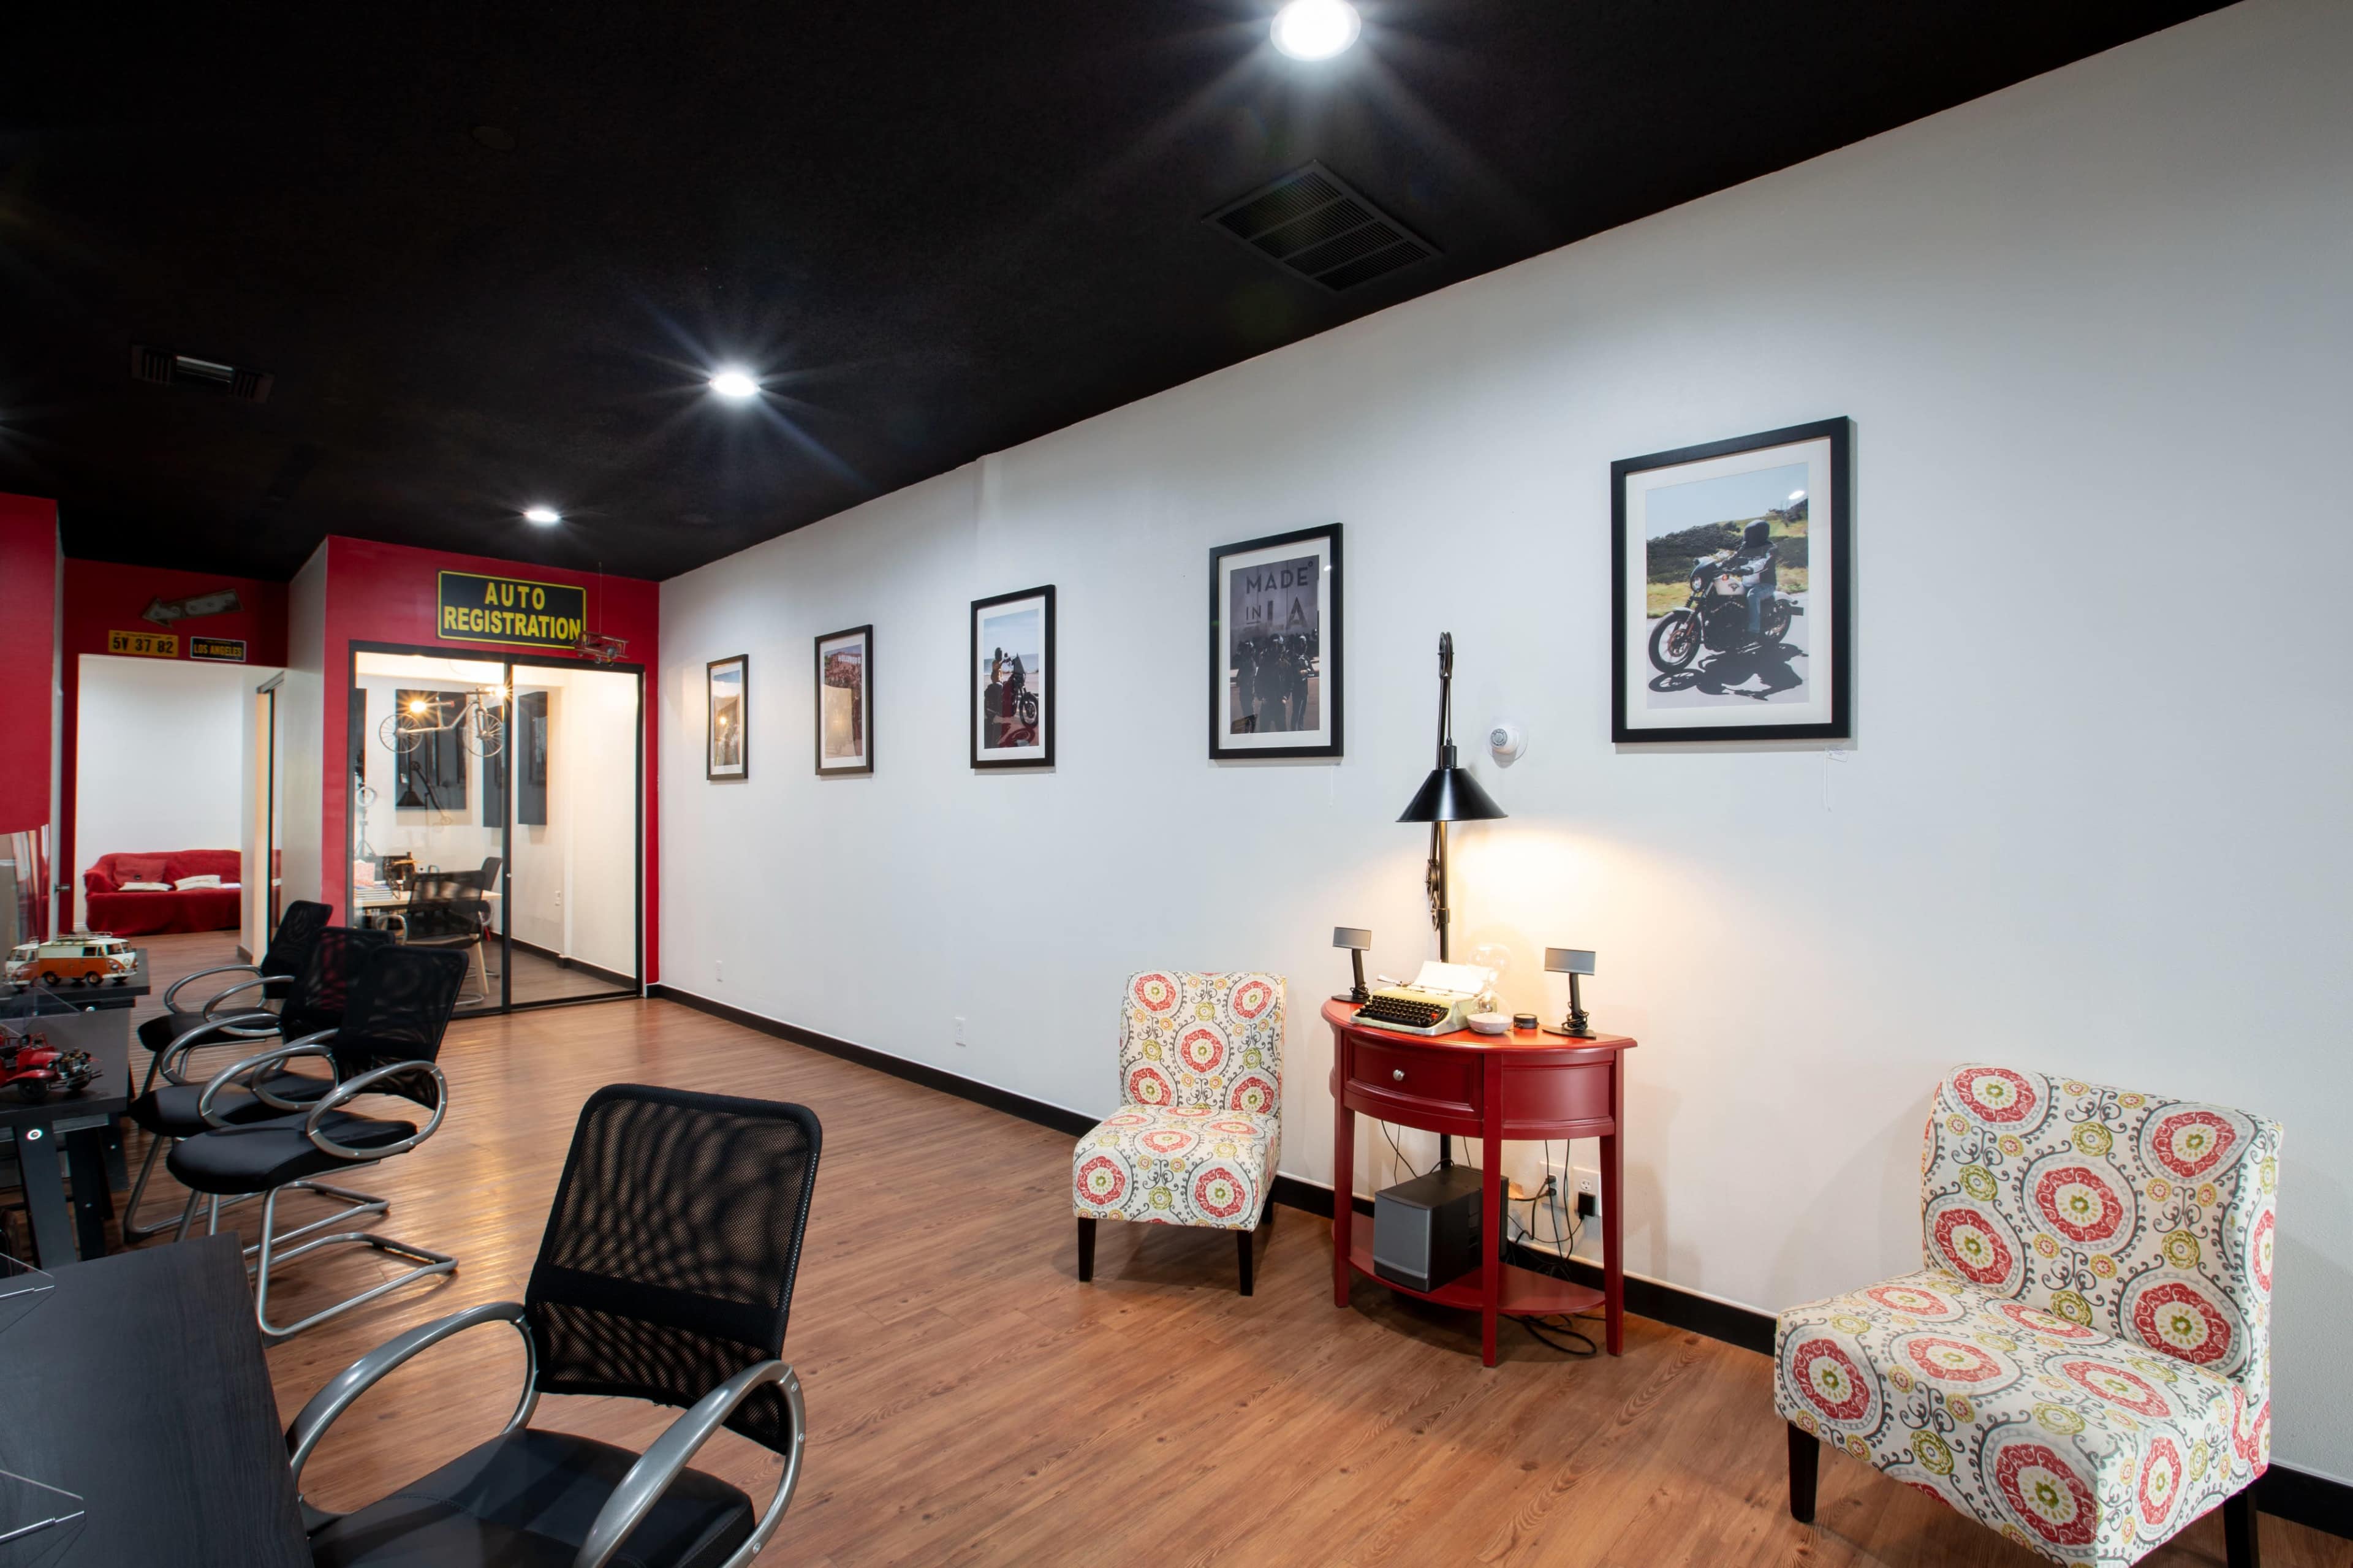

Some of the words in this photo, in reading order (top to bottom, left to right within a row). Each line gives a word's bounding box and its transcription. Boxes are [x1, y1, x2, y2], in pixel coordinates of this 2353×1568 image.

[1246, 567, 1308, 594] MADE
[485, 582, 545, 610] AUTO
[444, 605, 582, 640] REGISTRATION
[1246, 605, 1261, 621] IN
[135, 638, 151, 652] 37
[157, 640, 173, 653] 82
[194, 643, 208, 654] LOS
[210, 645, 242, 657] ANGELES
